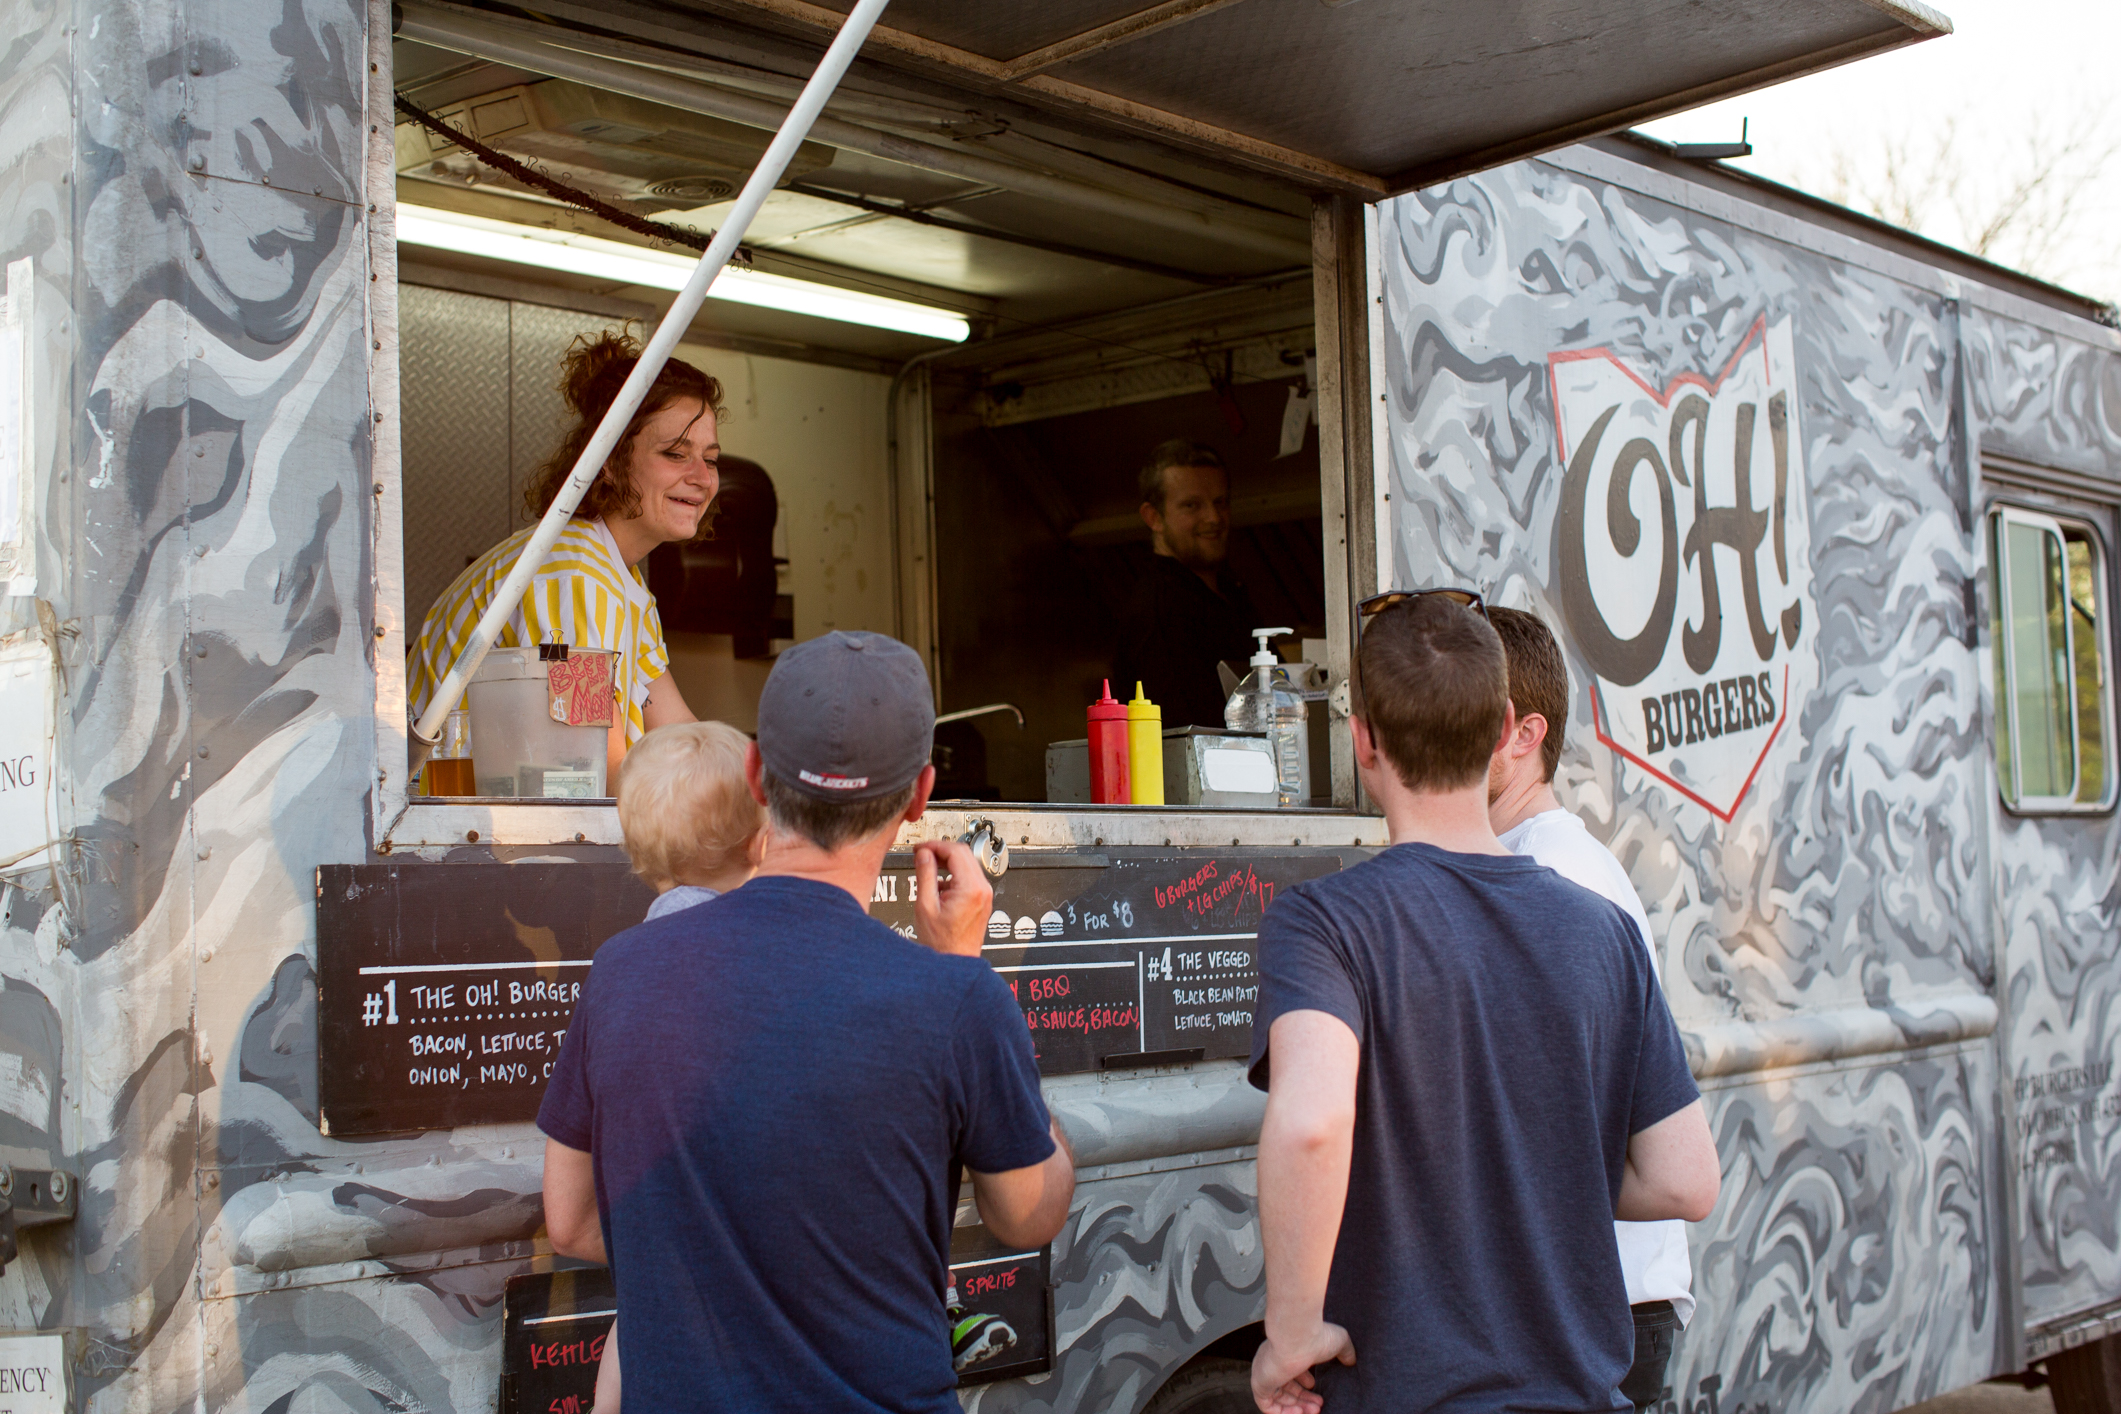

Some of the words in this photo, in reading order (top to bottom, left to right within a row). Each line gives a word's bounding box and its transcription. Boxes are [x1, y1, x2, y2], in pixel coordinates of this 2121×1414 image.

[1558, 390, 1802, 687] OH!
[549, 654, 609, 695] BEER
[1642, 671, 1776, 755] BURGERS
[1067, 905, 1077, 925] 3
[1083, 911, 1110, 931] FOR
[1147, 947, 1173, 982] #4
[1177, 951, 1203, 971] THE
[1208, 950, 1251, 969] VEGGED
[1029, 974, 1071, 1002] BBQ
[1173, 988, 1206, 1005] BLACK
[1208, 986, 1234, 1003] BEAN
[362, 979, 399, 1027] #1
[410, 984, 455, 1010] THE
[465, 979, 499, 1007] OH!
[508, 981, 580, 1003] BURGER
[1090, 1005, 1140, 1031] BACON,
[1174, 1014, 1216, 1032] LETTUCE,
[1216, 1010, 1254, 1028] TOMATO,
[408, 1034, 473, 1060] BACON,
[481, 1030, 551, 1056] LETTUCE,
[408, 1063, 469, 1089] ONION,
[966, 1267, 1020, 1296] SPRITE
[530, 1334, 607, 1370] KETTLE
